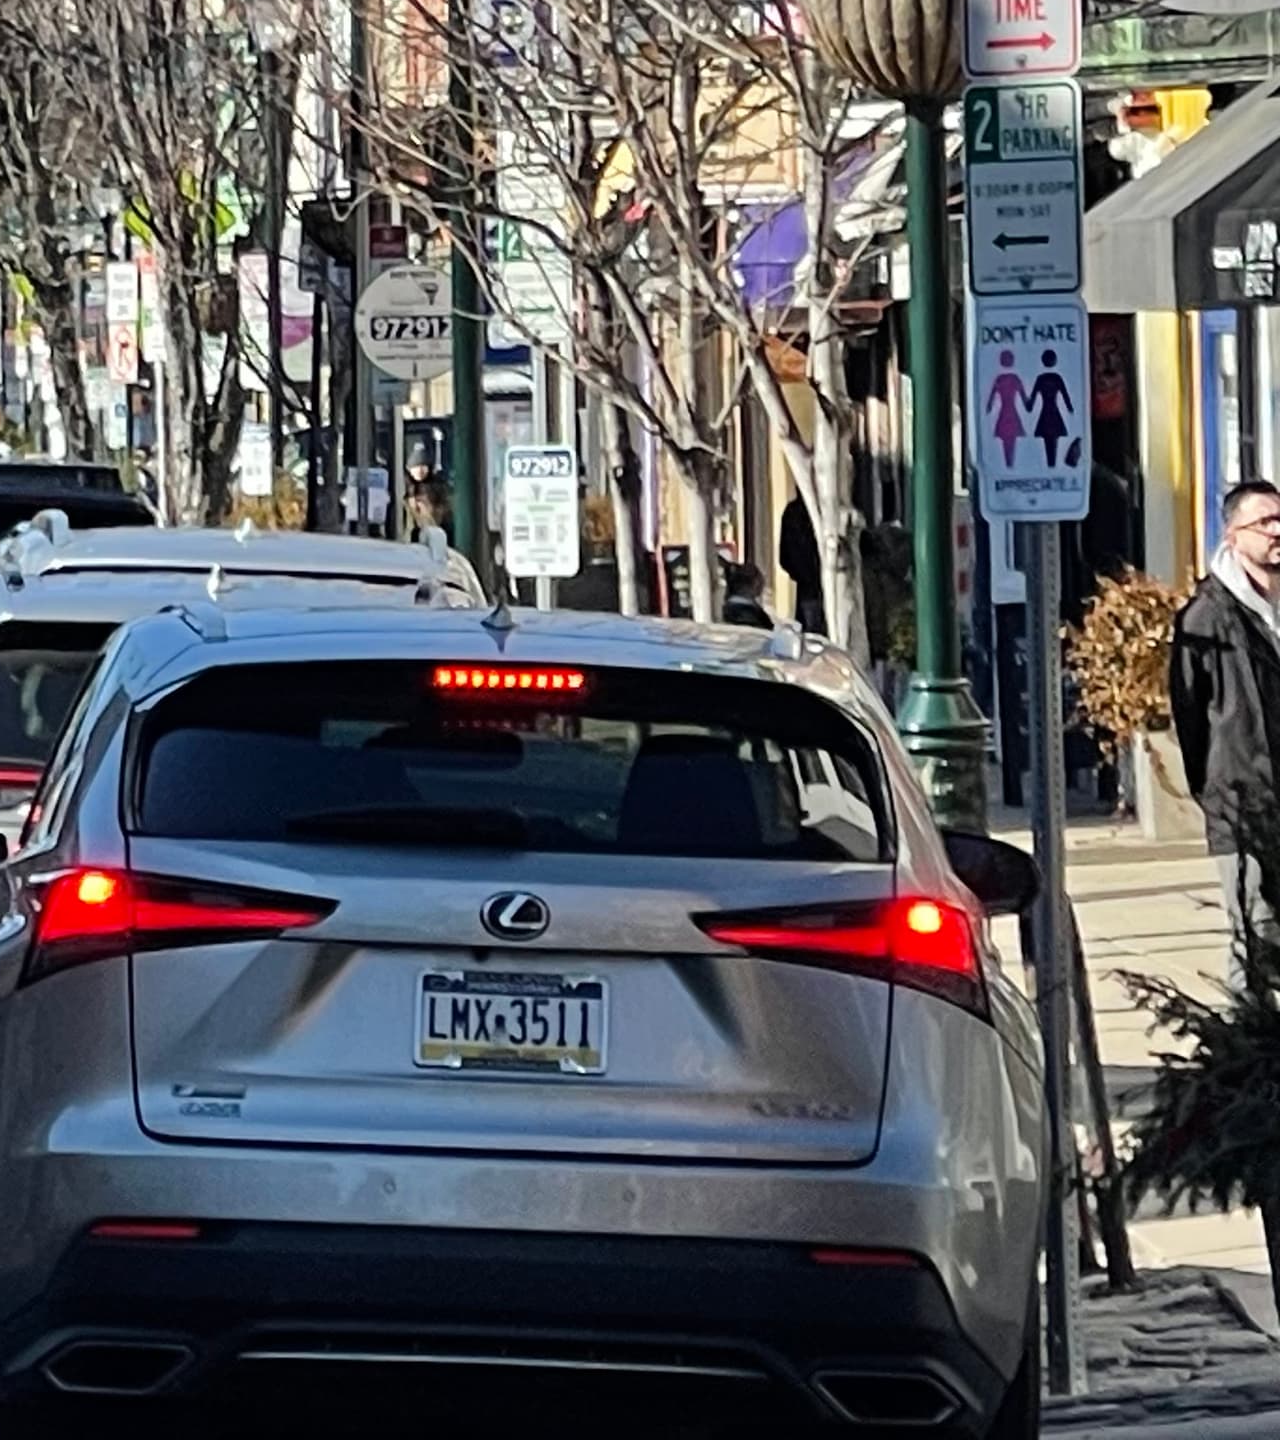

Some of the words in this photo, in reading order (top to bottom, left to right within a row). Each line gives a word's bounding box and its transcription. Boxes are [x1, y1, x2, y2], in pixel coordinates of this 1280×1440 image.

[1018, 92, 1050, 121] HR
[972, 99, 994, 152] 2
[1002, 125, 1072, 154] PARKING
[373, 316, 453, 341] 972912
[981, 325, 1029, 344] DON'T
[1034, 323, 1076, 343] HATE
[511, 456, 570, 475] 972912
[428, 996, 492, 1042] LMX
[509, 999, 590, 1048] 3511
